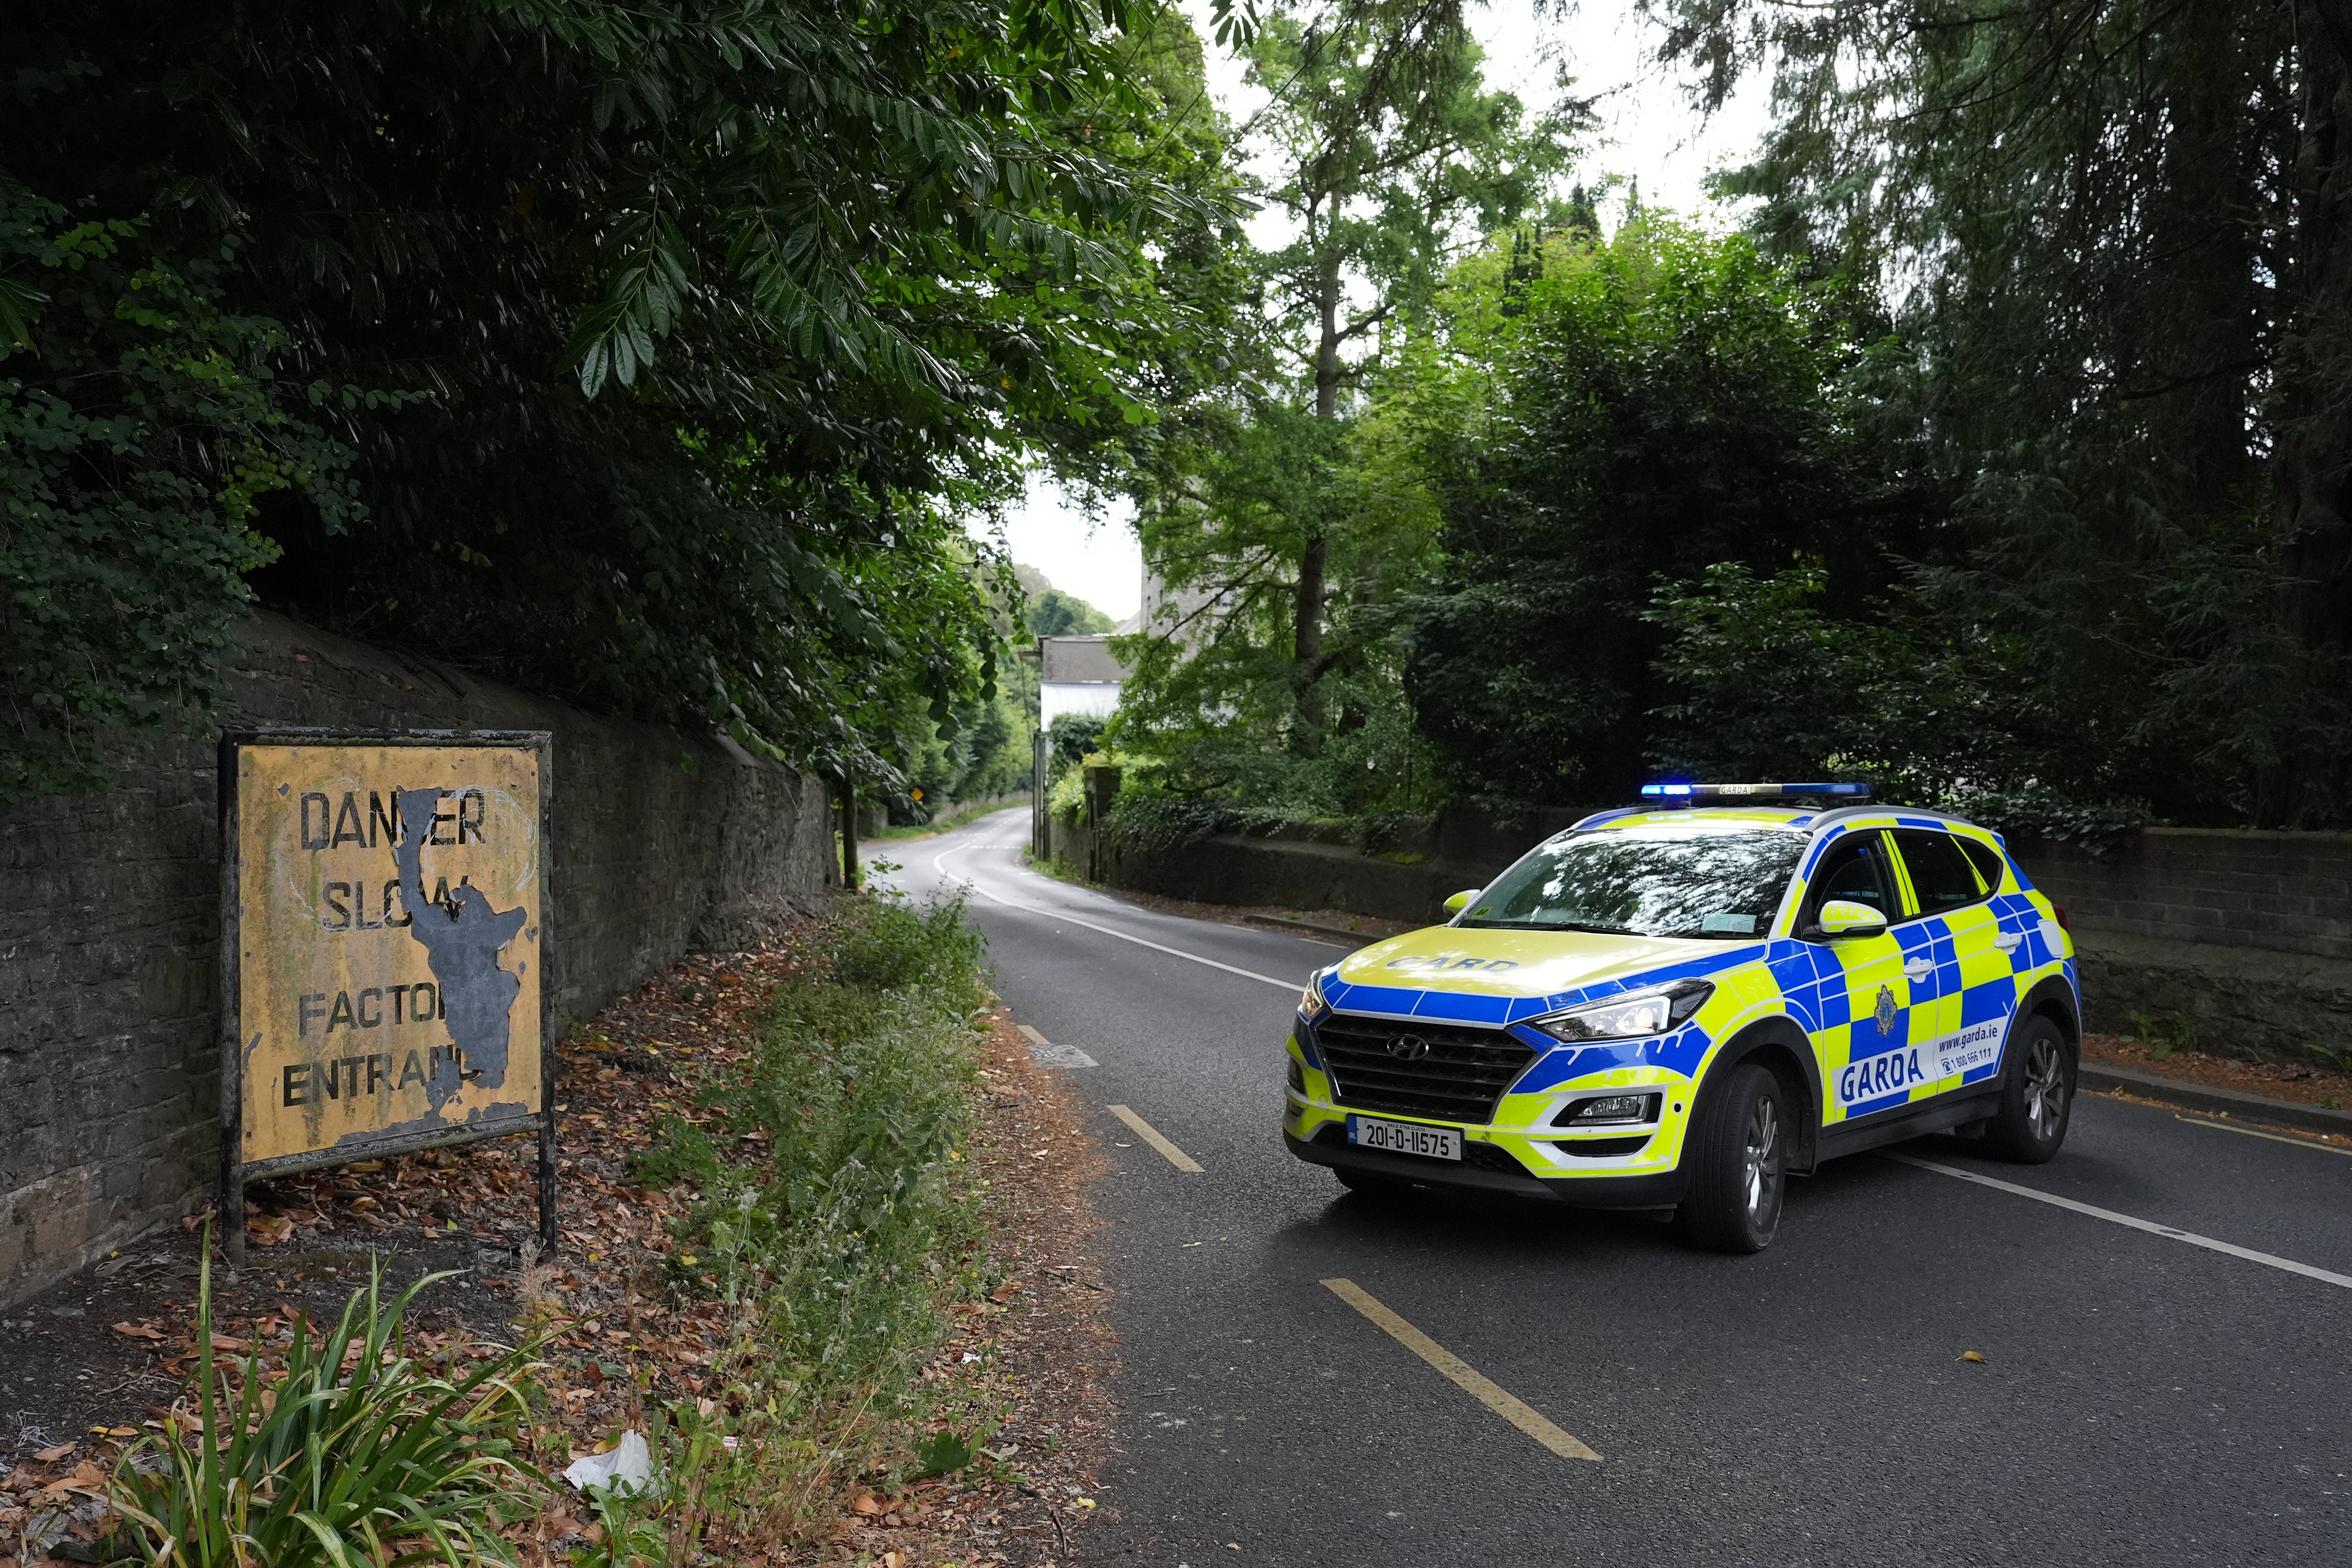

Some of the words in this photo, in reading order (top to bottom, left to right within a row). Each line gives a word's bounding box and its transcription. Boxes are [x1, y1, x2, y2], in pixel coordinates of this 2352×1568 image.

[301, 789, 486, 851] DANER
[1940, 1024, 1997, 1053] www.garda.ie
[1951, 1059, 1956, 1069] 1
[1956, 1055, 1967, 1067] 800
[1967, 1051, 1978, 1063] 666
[1979, 1047, 1991, 1059] 111
[1841, 1049, 1924, 1102] GARDA
[1367, 1125, 1449, 1156] 201-D-11575
